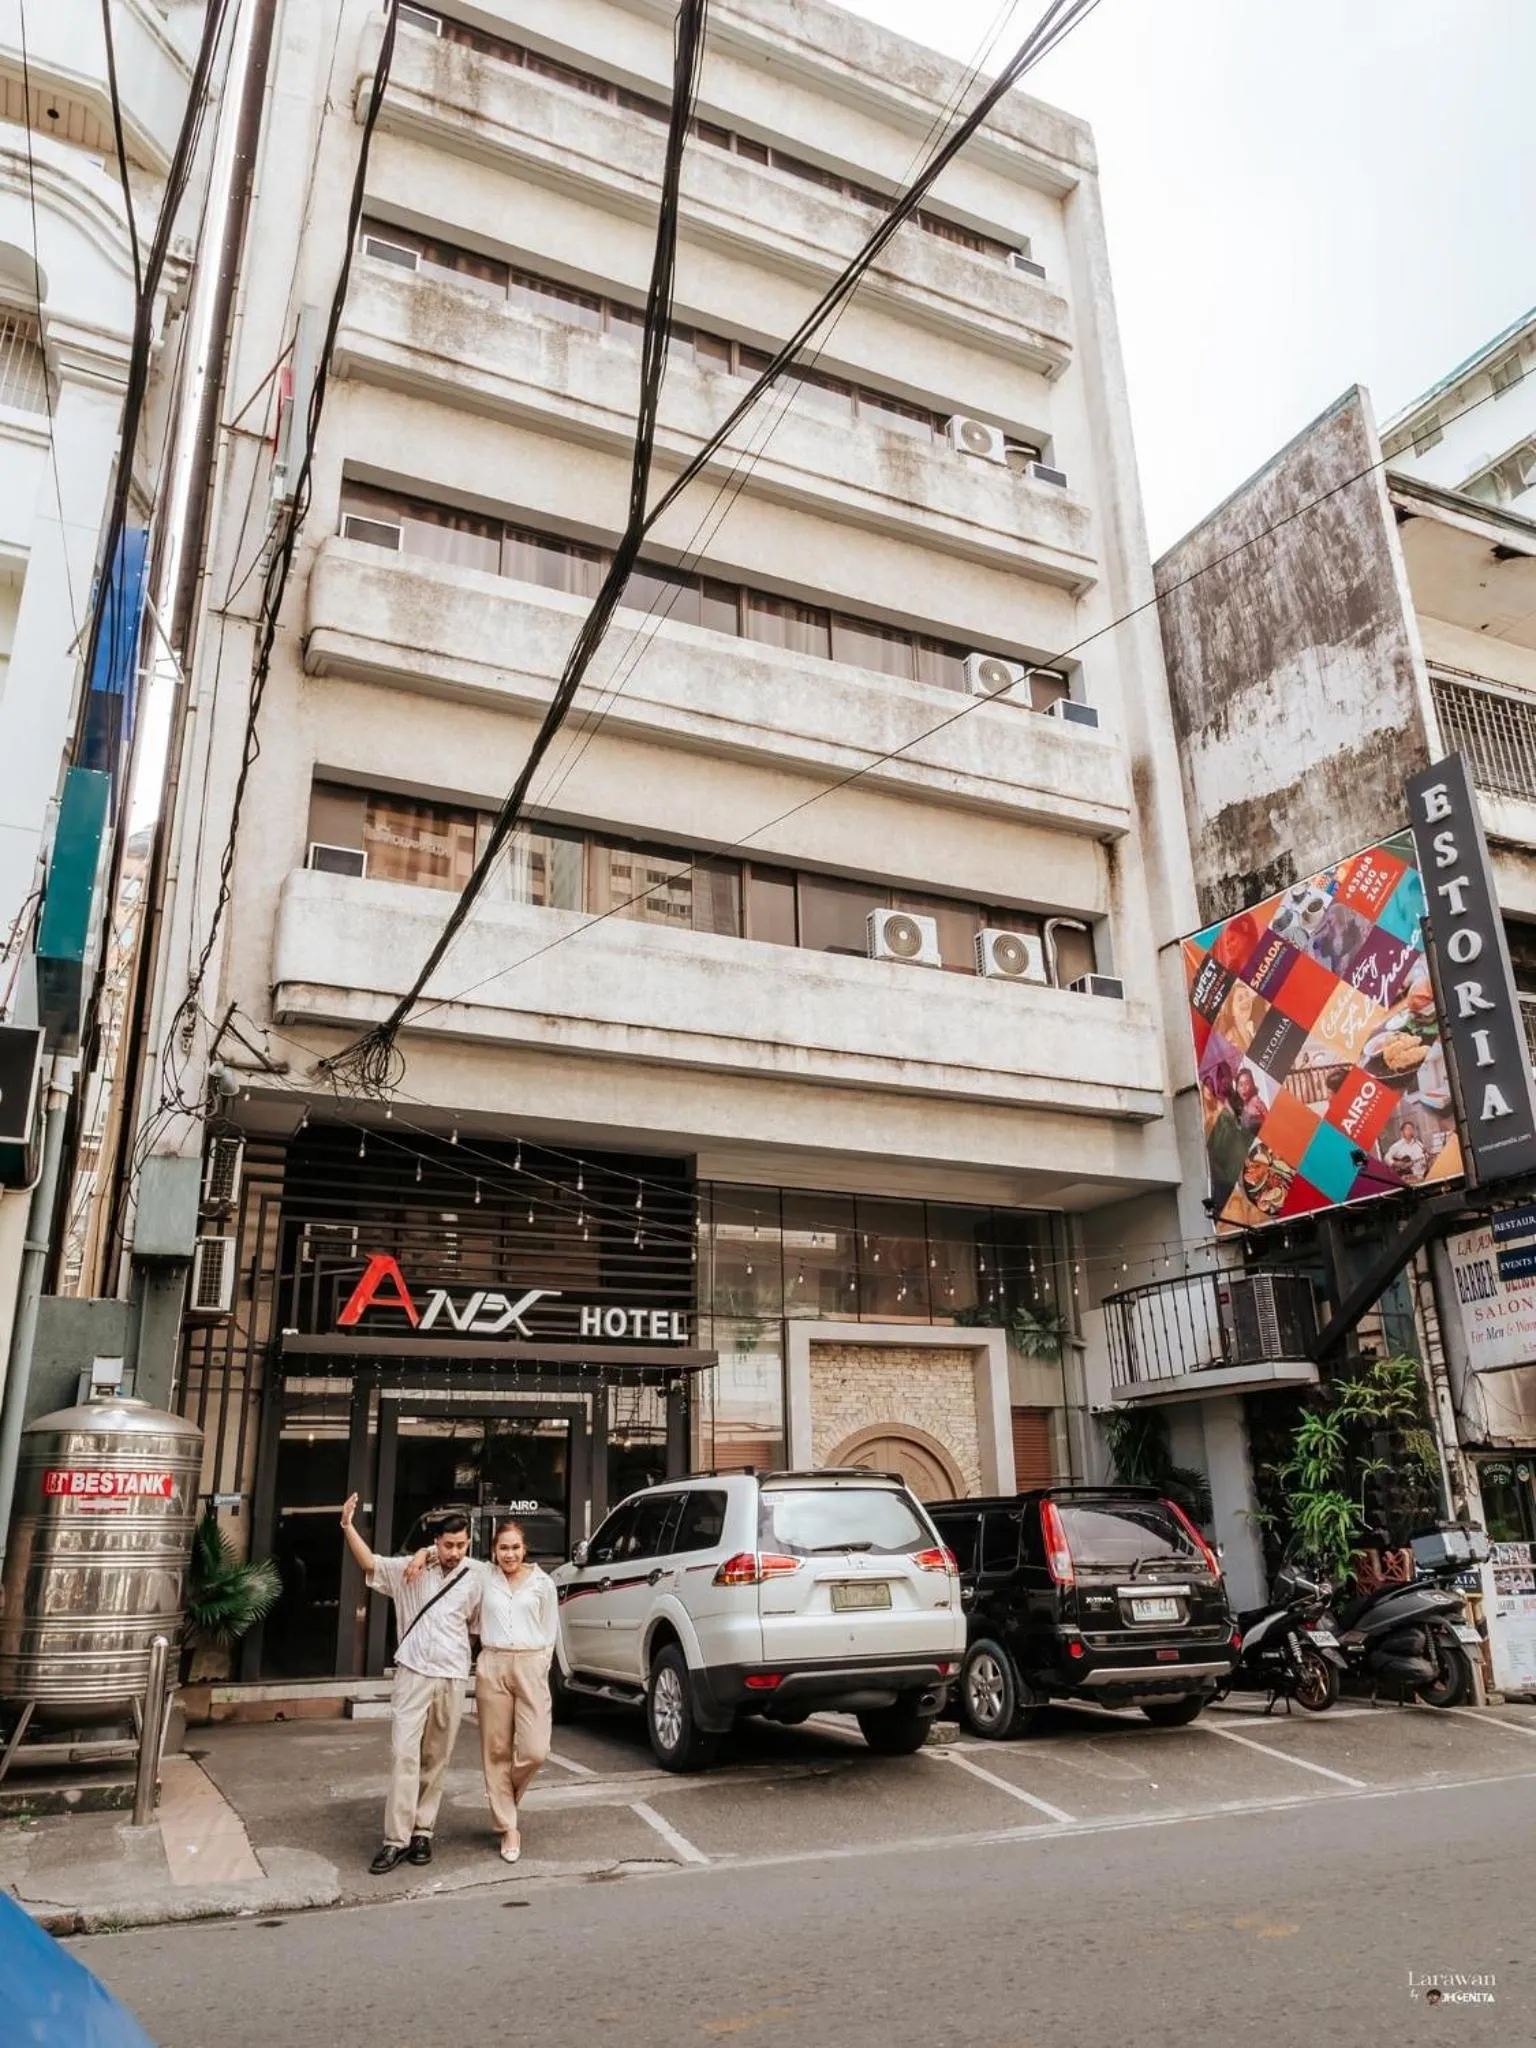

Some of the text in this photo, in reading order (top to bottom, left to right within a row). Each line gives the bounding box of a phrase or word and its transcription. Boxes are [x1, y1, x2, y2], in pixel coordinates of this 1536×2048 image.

[1250, 940, 1282, 990] SAGADA
[1421, 783, 1514, 1121] ESTORIA
[1258, 1017, 1290, 1068] ESTORIA
[1341, 1081, 1376, 1136] AIRO
[1454, 1260, 1498, 1304] BARBER
[1500, 1257, 1532, 1272] EVENTS
[579, 1305, 689, 1341] HOTEL
[1474, 1297, 1535, 1322] SALON
[1486, 1326, 1504, 1341] Men
[70, 1471, 166, 1494] BESTANK
[509, 1500, 539, 1510] AIRO
